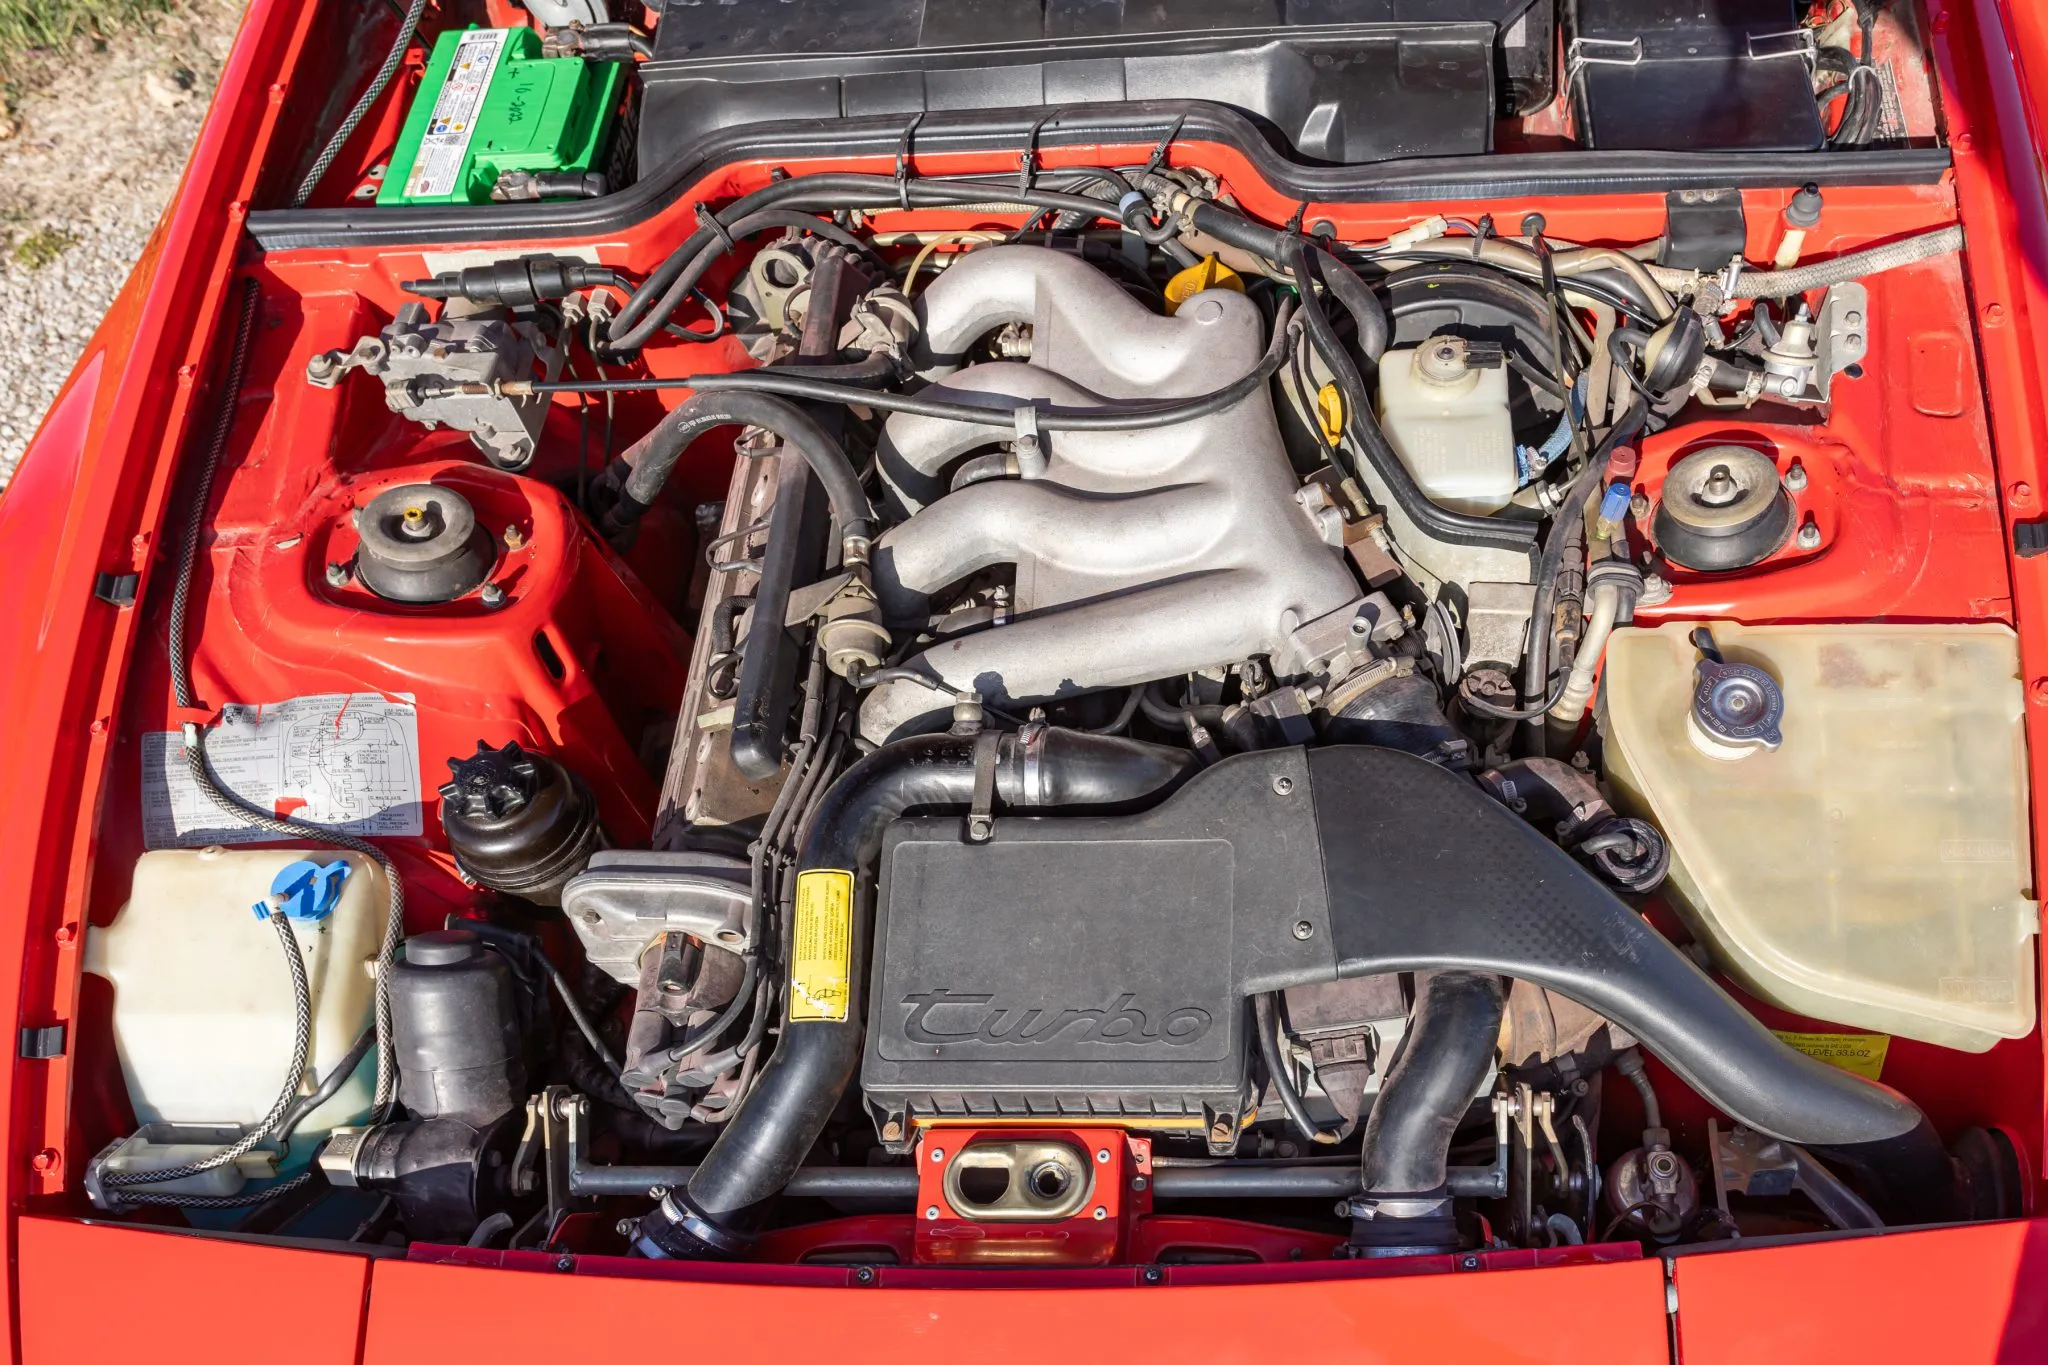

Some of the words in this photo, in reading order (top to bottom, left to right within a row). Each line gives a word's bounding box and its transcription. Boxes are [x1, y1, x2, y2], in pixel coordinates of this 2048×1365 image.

[1701, 708, 1728, 733] BEHR
[1807, 1048, 1835, 1057] LEVEL
[1835, 1049, 1856, 1057] 33.5
[1856, 1049, 1872, 1058] OZ
